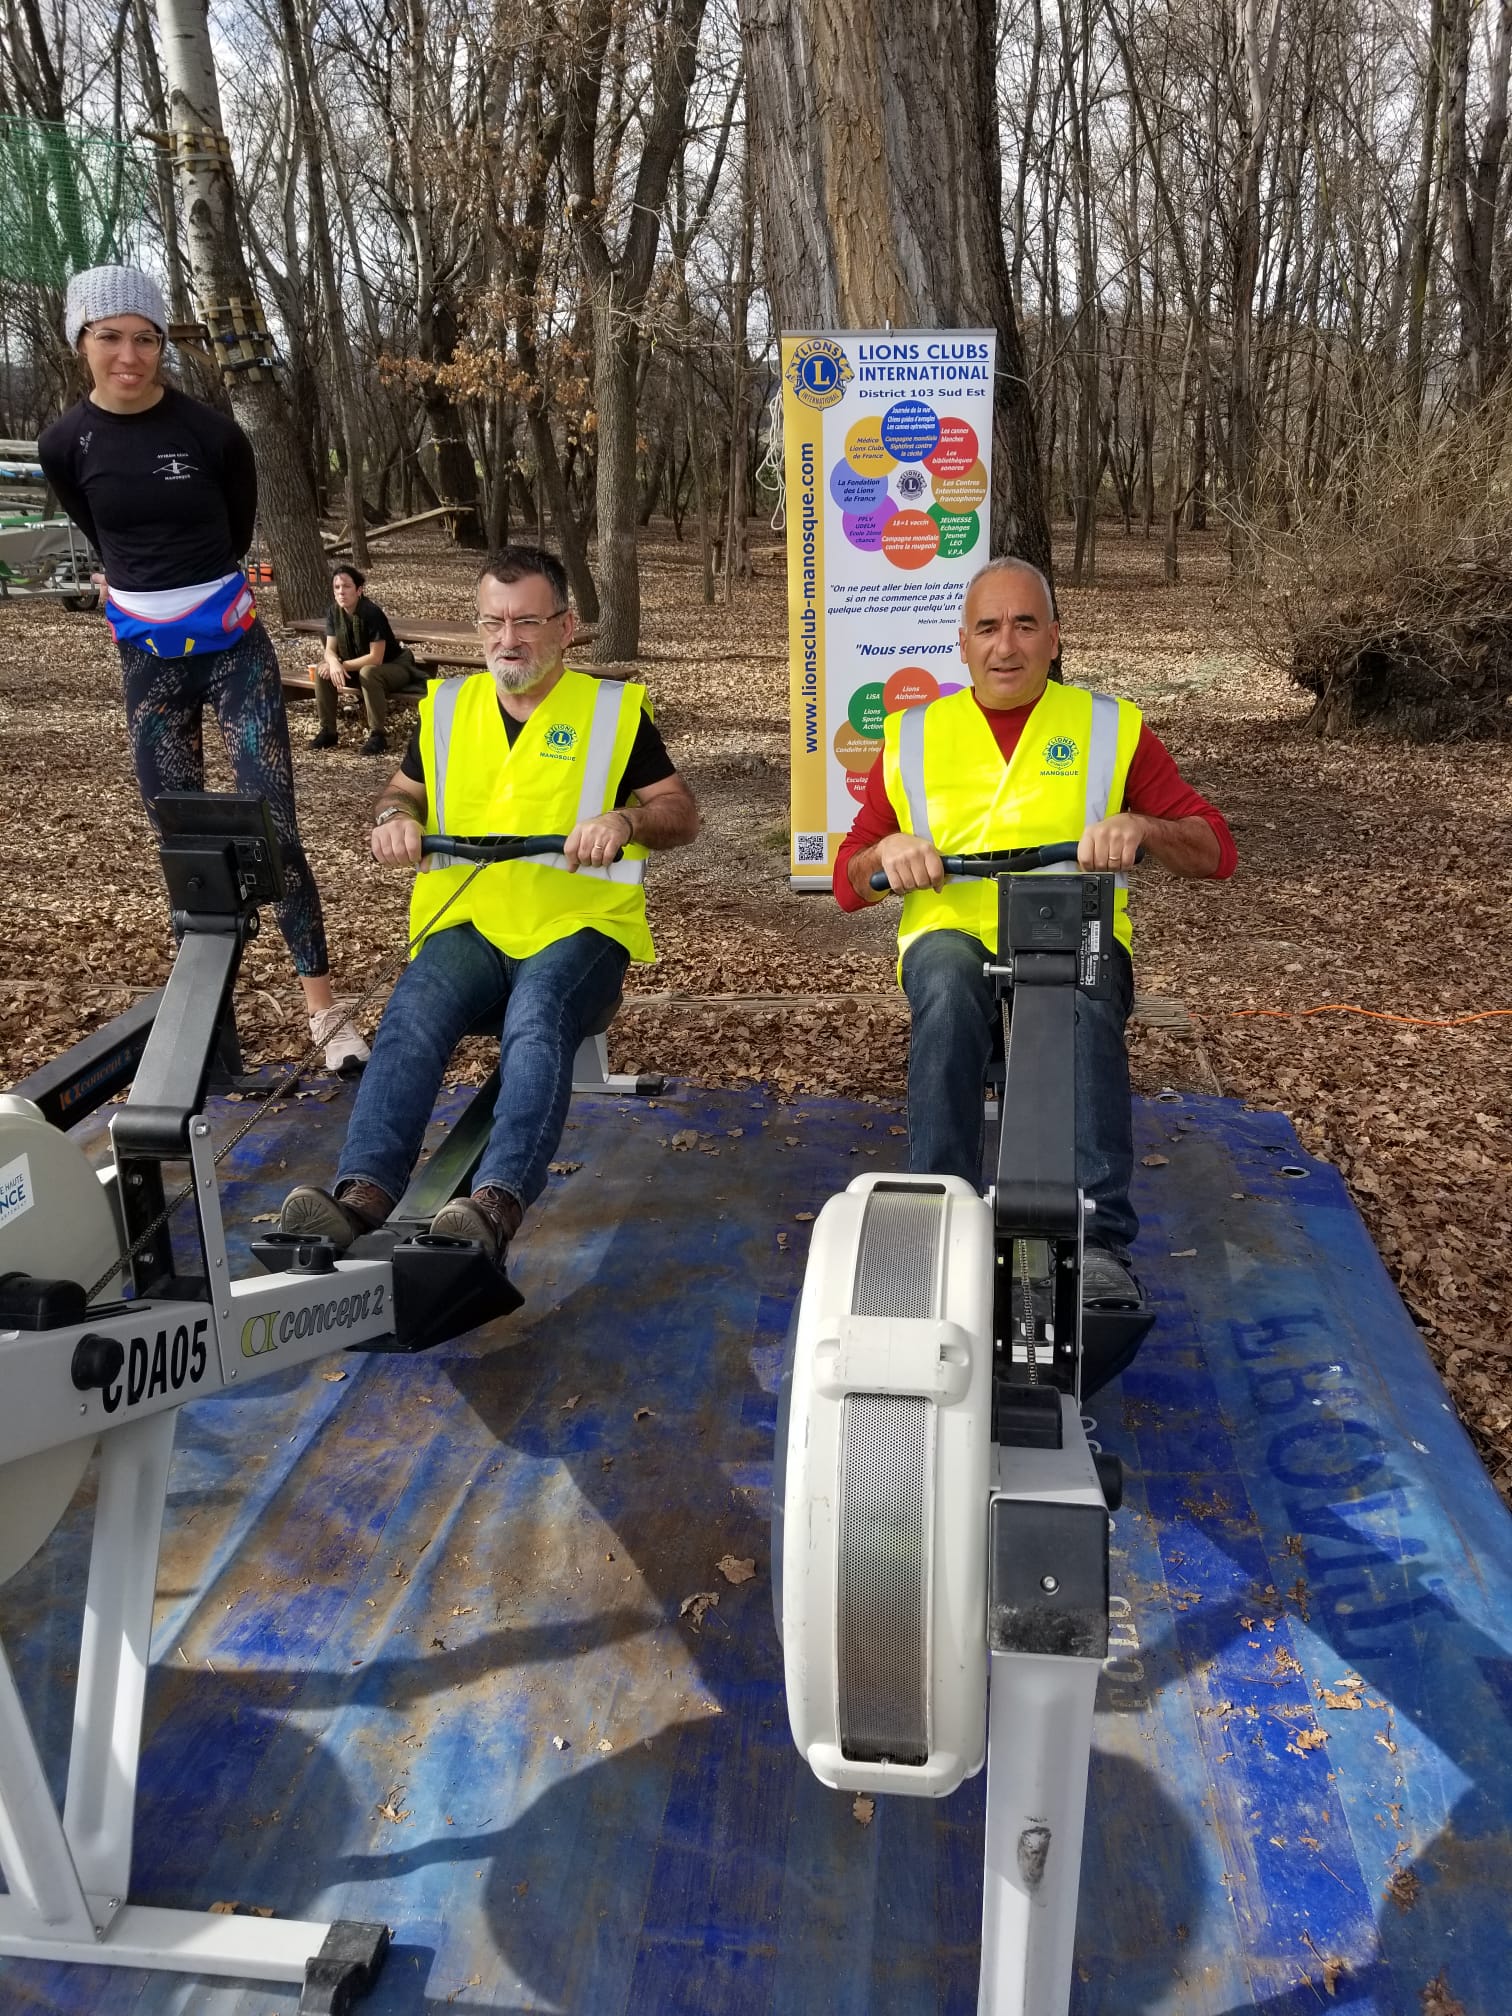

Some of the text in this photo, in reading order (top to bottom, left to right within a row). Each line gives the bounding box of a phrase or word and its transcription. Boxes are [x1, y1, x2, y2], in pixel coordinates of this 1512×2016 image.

[801, 341, 839, 356] LIONS
[859, 344, 989, 360] LIONS CLUBS
[813, 360, 830, 386] L
[859, 366, 989, 381] INTERNATIONAL
[800, 391, 840, 406] INTERNATIONAL
[859, 388, 986, 398] District 103 Sud Est
[830, 584, 845, 592] "On
[860, 584, 880, 593] peut
[882, 583, 901, 591] aller
[903, 583, 922, 591] bien
[924, 582, 940, 590] loin
[942, 582, 964, 590] dans
[801, 441, 819, 753] www.lionsclub-manosque.com
[881, 594, 928, 602] commence
[929, 594, 945, 602] pas
[946, 592, 952, 600] à
[954, 592, 964, 600] fa
[827, 605, 862, 615] quelque
[864, 605, 888, 613] chose
[890, 604, 911, 614] pour
[912, 603, 955, 614] quelqu'un
[856, 644, 896, 656] "Nous
[540, 751, 577, 761] MANOSQUE
[1056, 746, 1066, 758] L
[0, 1184, 26, 1214] NCE
[279, 1284, 386, 1344] concept 2
